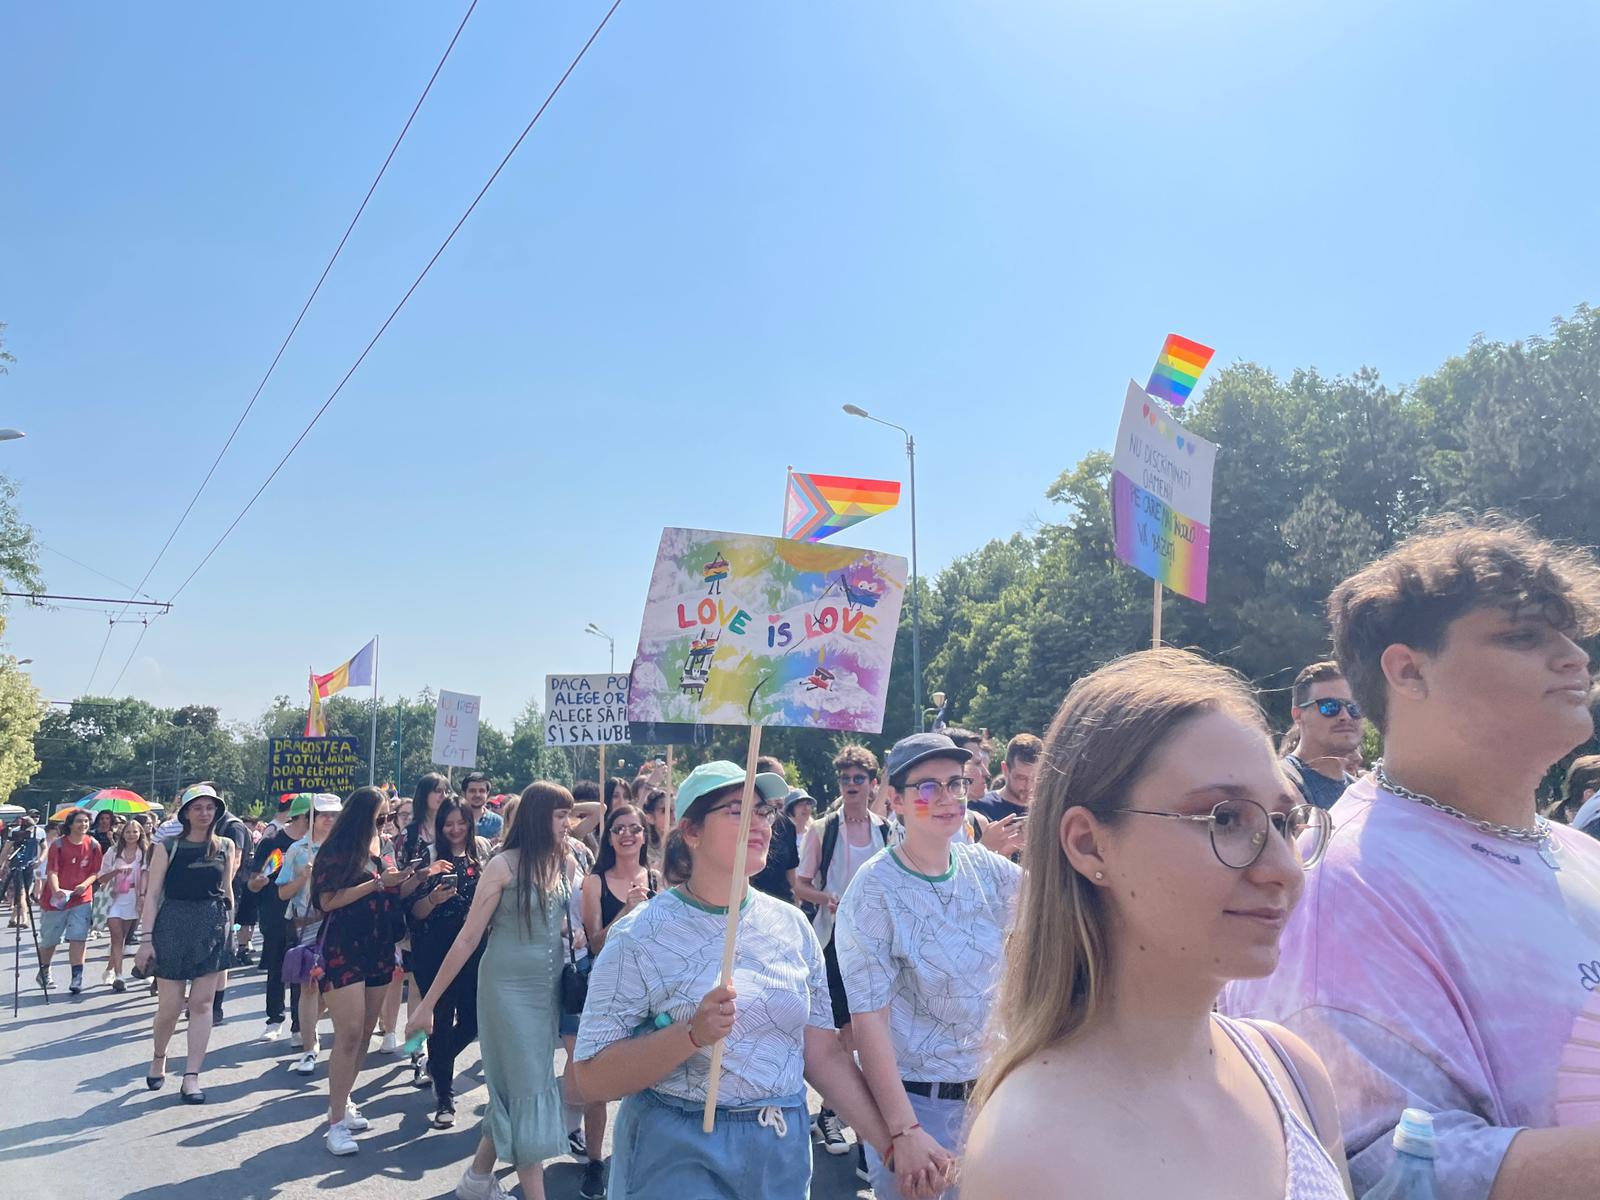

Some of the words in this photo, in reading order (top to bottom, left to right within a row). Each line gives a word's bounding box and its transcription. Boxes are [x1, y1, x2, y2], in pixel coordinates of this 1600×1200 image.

[1129, 432, 1141, 457] NU
[677, 598, 752, 635] LOVE
[804, 607, 879, 641] LOVE
[607, 675, 629, 690] PO
[555, 692, 600, 706] ALEGE
[603, 692, 626, 705] OR
[549, 708, 592, 722] ALEGE
[598, 725, 632, 742] IUBE
[274, 740, 351, 753] DRAGOSTEA
[273, 754, 280, 764] E
[273, 765, 304, 777] DOAR
[307, 765, 355, 777] ELEMENTE
[271, 778, 294, 792] ALE
